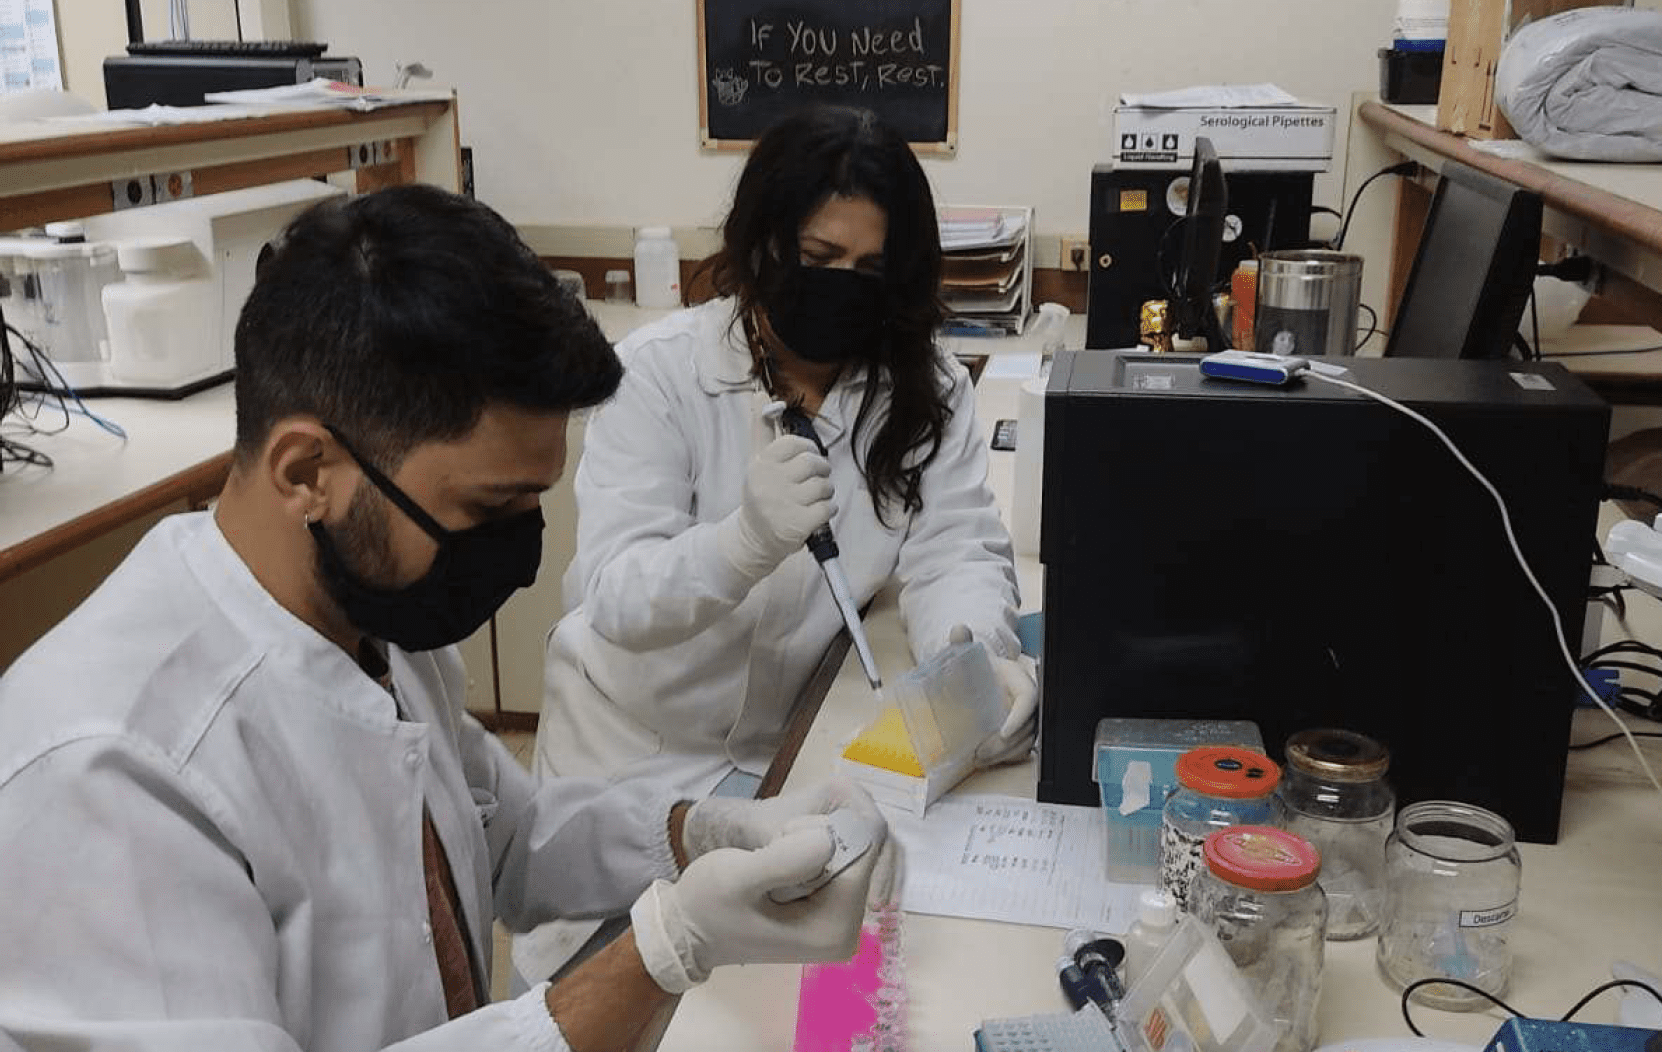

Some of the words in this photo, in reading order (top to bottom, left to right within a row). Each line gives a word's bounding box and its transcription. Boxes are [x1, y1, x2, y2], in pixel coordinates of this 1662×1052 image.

[750, 18, 774, 51] IF
[786, 19, 837, 56] YOU
[851, 15, 924, 55] Need
[1200, 115, 1269, 129] Serological
[1272, 115, 1324, 129] Pipettes
